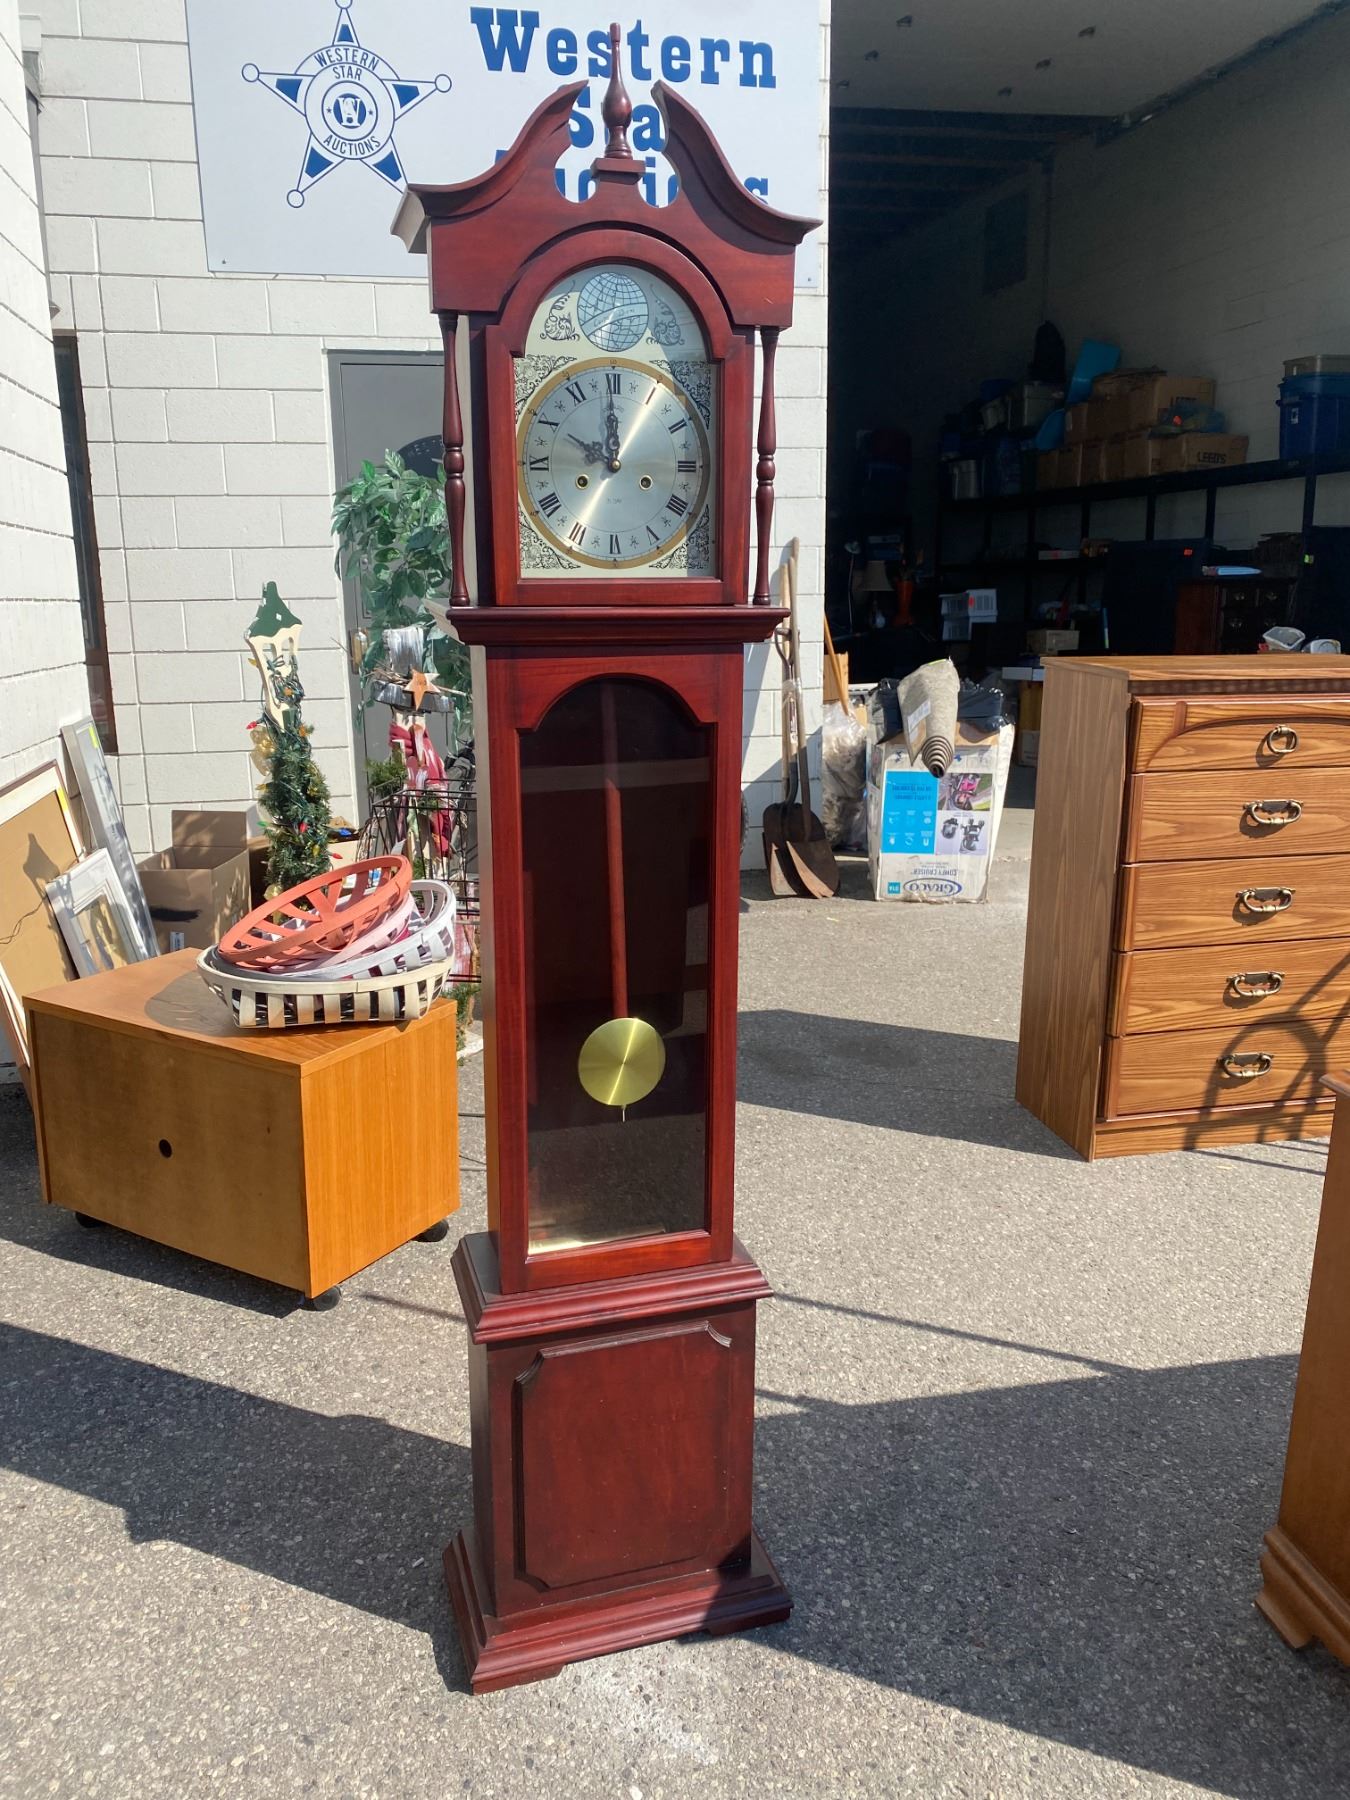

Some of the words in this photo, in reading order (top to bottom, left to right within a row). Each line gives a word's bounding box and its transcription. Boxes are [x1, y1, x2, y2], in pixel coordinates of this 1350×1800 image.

[470, 6, 777, 88] Western
[314, 47, 379, 71] WESTERN
[332, 65, 363, 81] STAR
[323, 134, 380, 156] AUCTIONS
[565, 381, 587, 407] XI
[909, 883, 955, 893] GRACO
